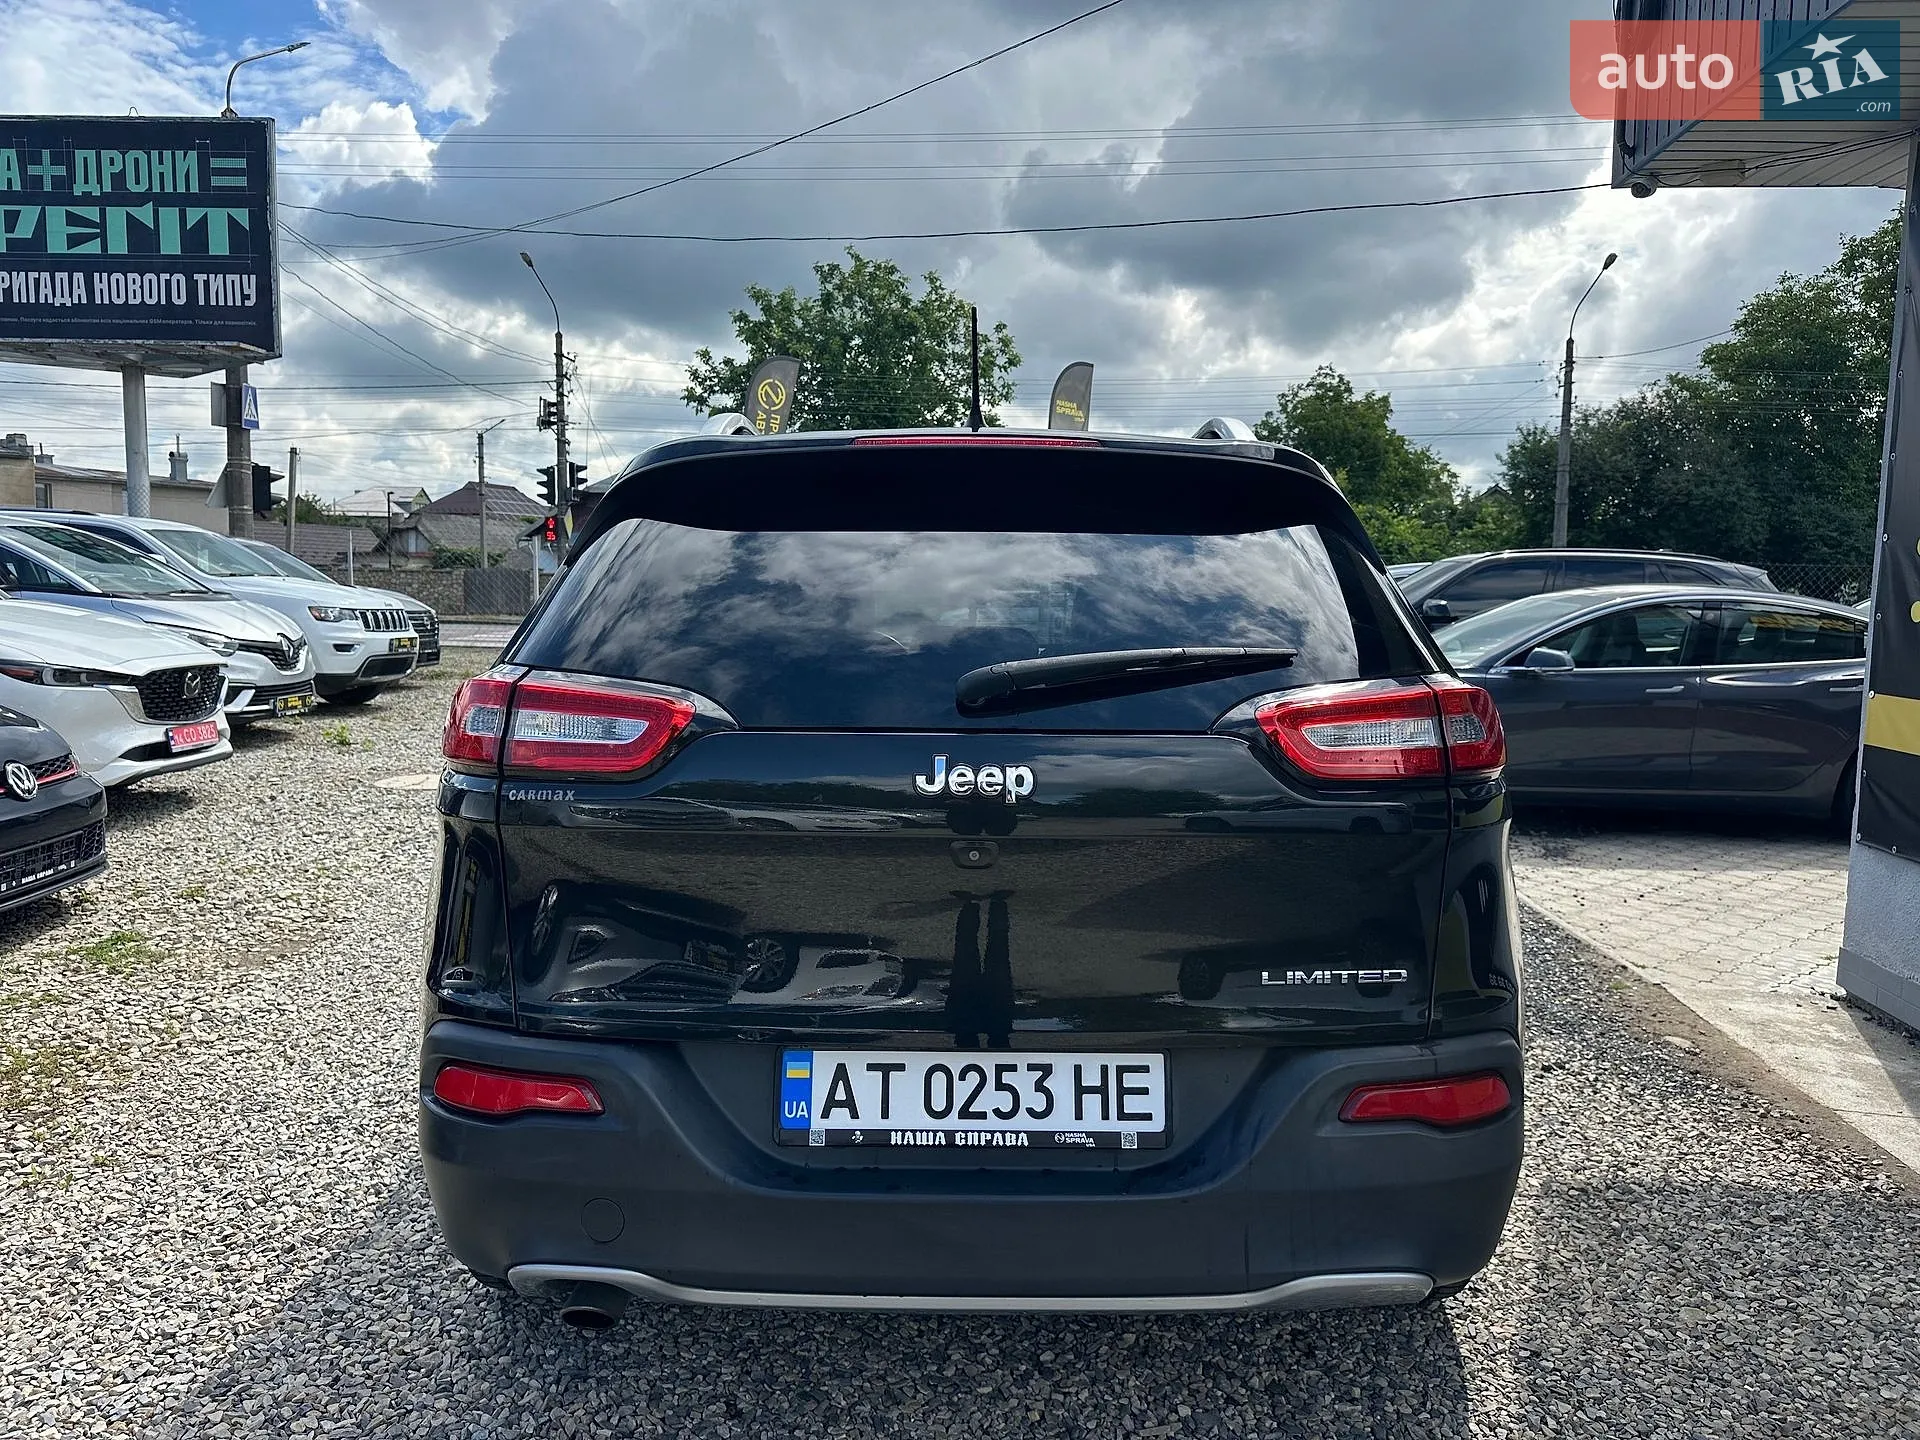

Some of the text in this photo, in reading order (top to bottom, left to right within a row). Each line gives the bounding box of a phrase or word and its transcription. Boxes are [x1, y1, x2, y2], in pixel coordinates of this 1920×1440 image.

[73, 150, 199, 196] ДРОНИ
[93, 272, 187, 305] НОВОГО
[193, 274, 257, 306] ТИПУ
[913, 754, 1037, 805] Jeep
[1261, 969, 1408, 985] LIMITED
[820, 1062, 1153, 1121] AT 0253 HE
[784, 1101, 809, 1119] UA
[890, 1130, 1029, 1147] НАША СПРАВА
[1065, 1137, 1095, 1145] SPRAVA
